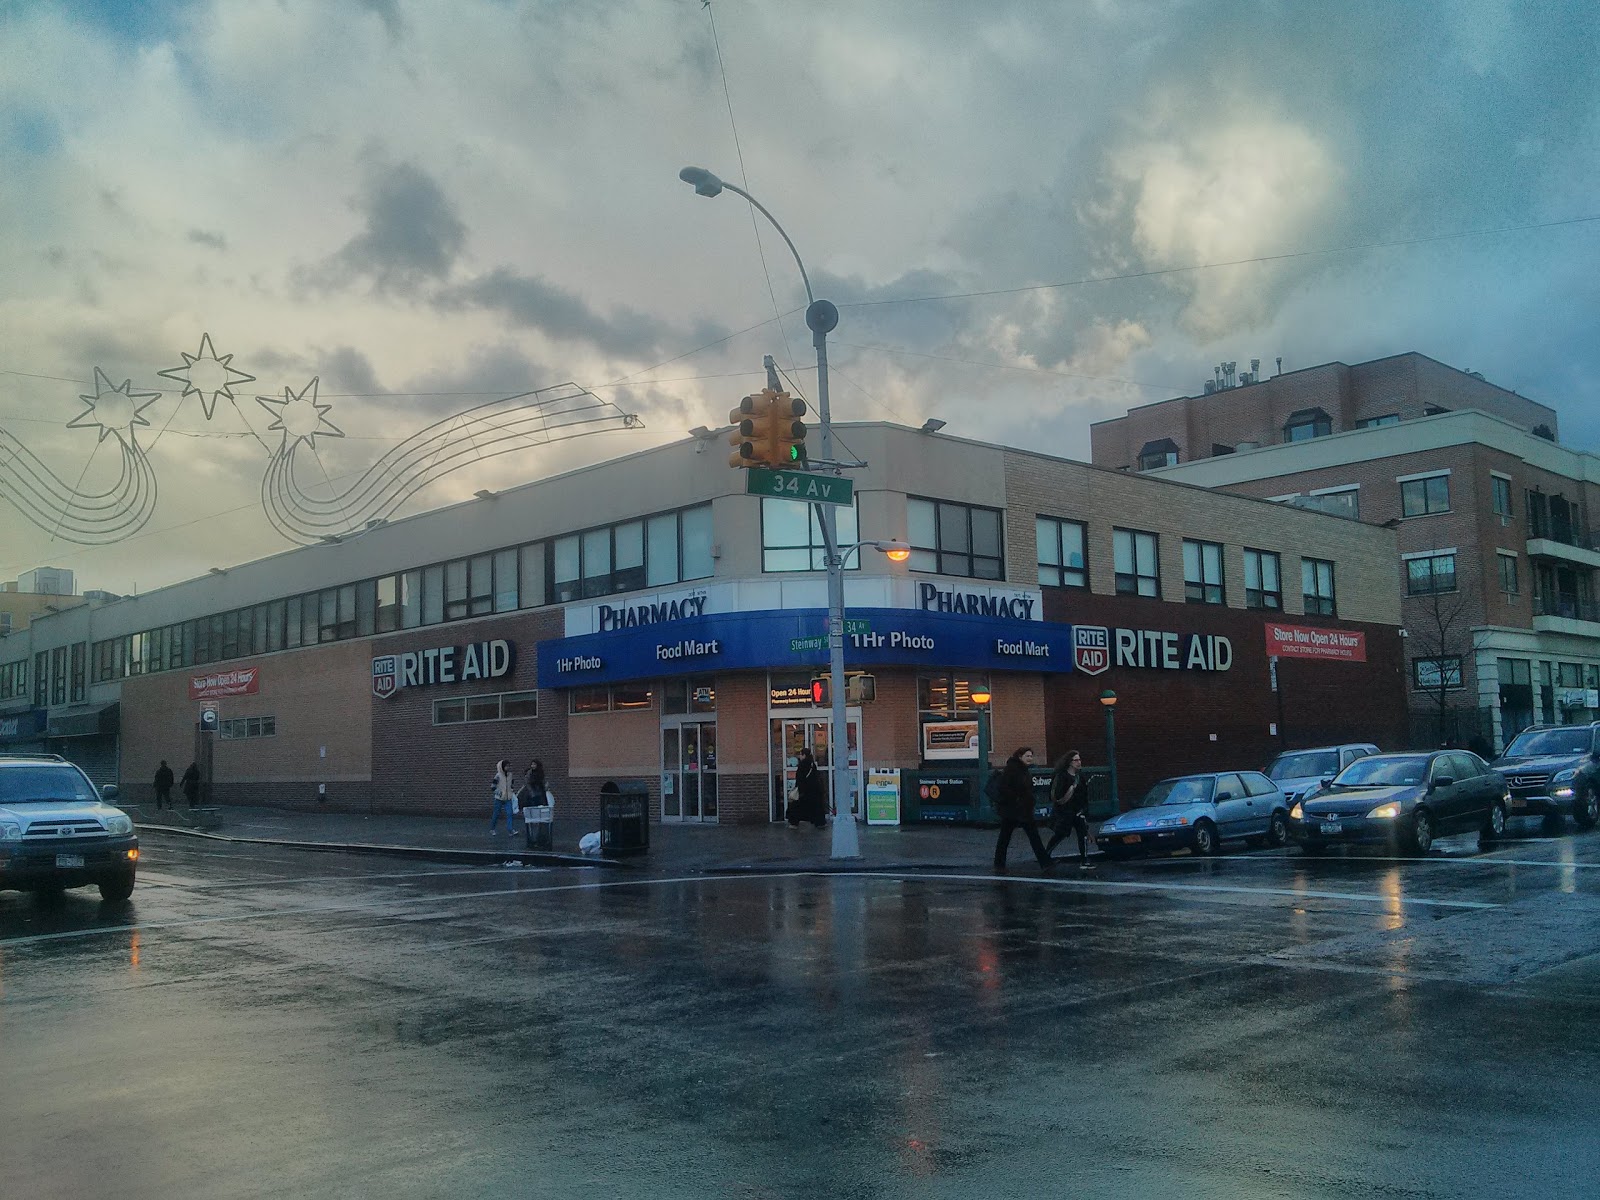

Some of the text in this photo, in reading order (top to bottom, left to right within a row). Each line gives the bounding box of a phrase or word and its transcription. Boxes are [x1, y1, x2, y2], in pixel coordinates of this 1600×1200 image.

[773, 475, 831, 497] 34 Av
[920, 583, 1034, 620] PHARMACY
[598, 596, 707, 632] PHARMACY
[847, 621, 857, 632] 34
[791, 637, 822, 650] Steinway
[851, 631, 934, 649] 1Hr Photo
[1078, 630, 1105, 646] RITE
[1274, 628, 1358, 647] Store Now Open 24 Hours
[656, 639, 718, 659] Food Mart
[997, 639, 1049, 657] Food Mart
[1115, 627, 1233, 671] RITE AID
[374, 659, 393, 674] RITE
[402, 639, 510, 687] RITE AID
[556, 656, 601, 672] 1Hr Photo
[1081, 650, 1103, 667] AID
[377, 676, 391, 691] AID
[771, 689, 787, 698] Open
[788, 688, 797, 696] 24
